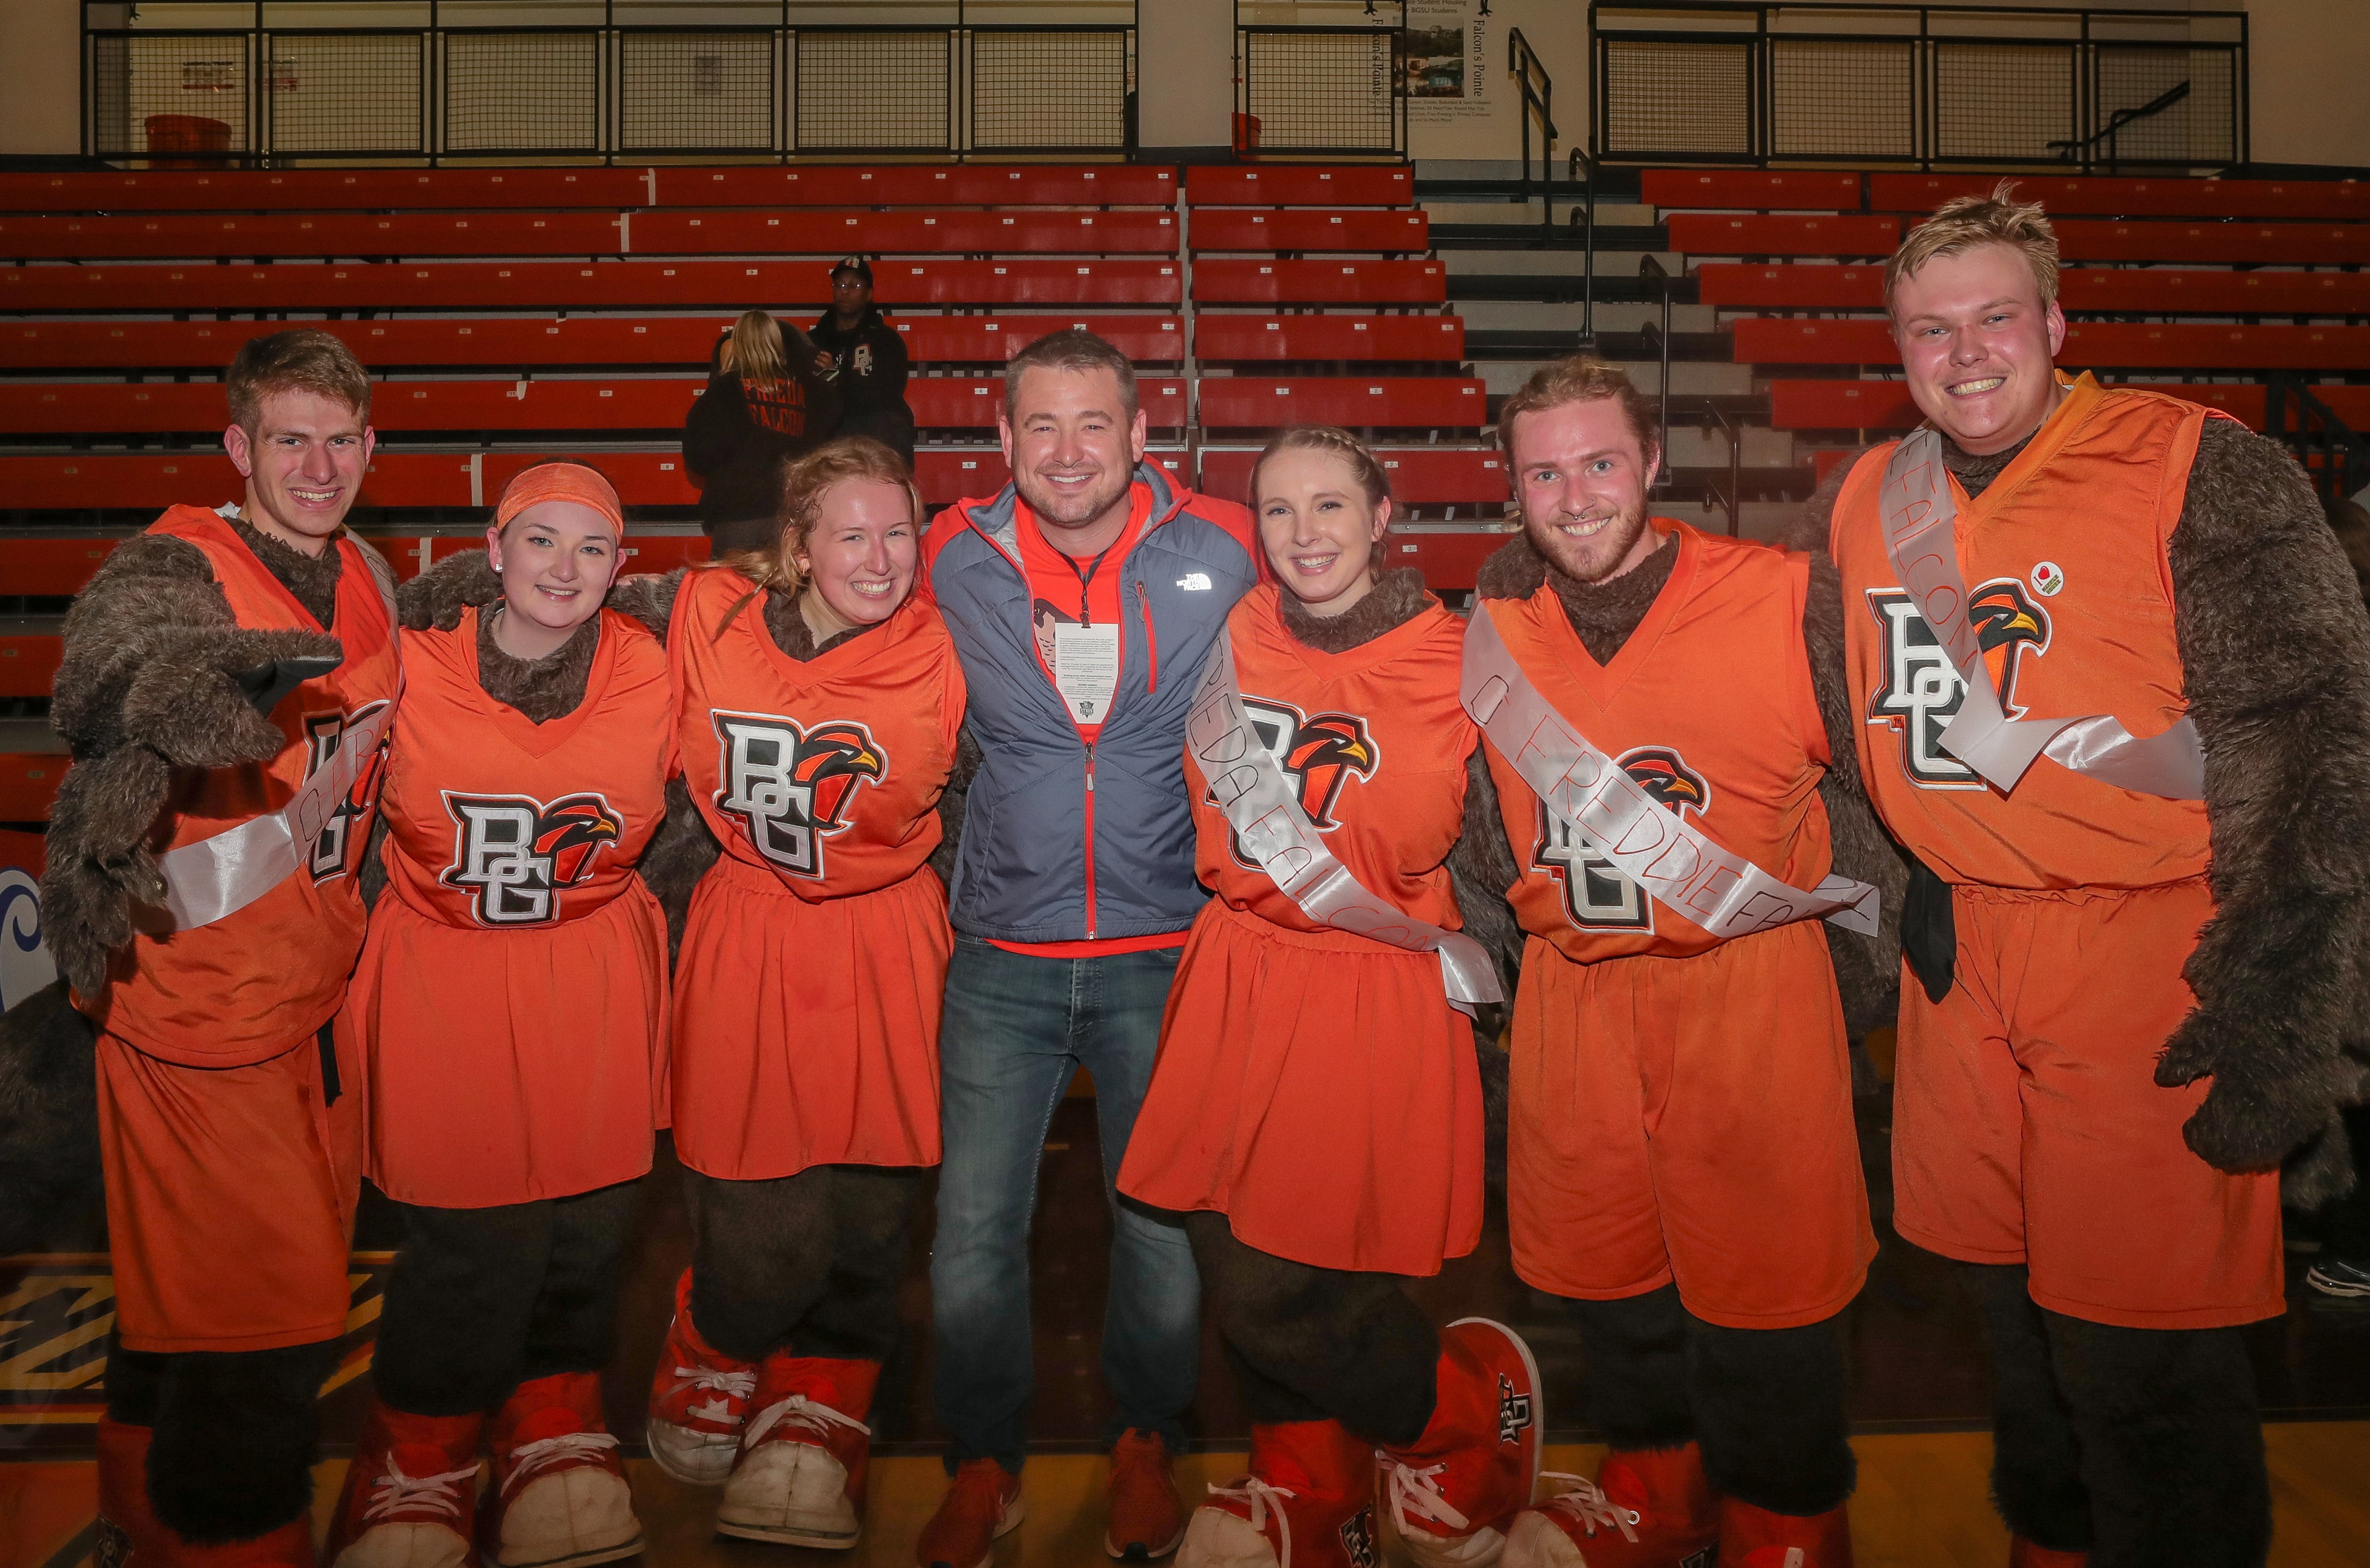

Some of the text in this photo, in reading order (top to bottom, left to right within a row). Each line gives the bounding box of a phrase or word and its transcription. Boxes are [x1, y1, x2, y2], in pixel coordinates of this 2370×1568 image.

[1372, 64, 1384, 96] Pointe
[1473, 20, 1485, 97] Falcon's Pointe
[1884, 460, 1979, 668] FALCON
[725, 723, 812, 870] BG
[1515, 713, 1743, 917] FREDDIE
[456, 806, 551, 921] BG
